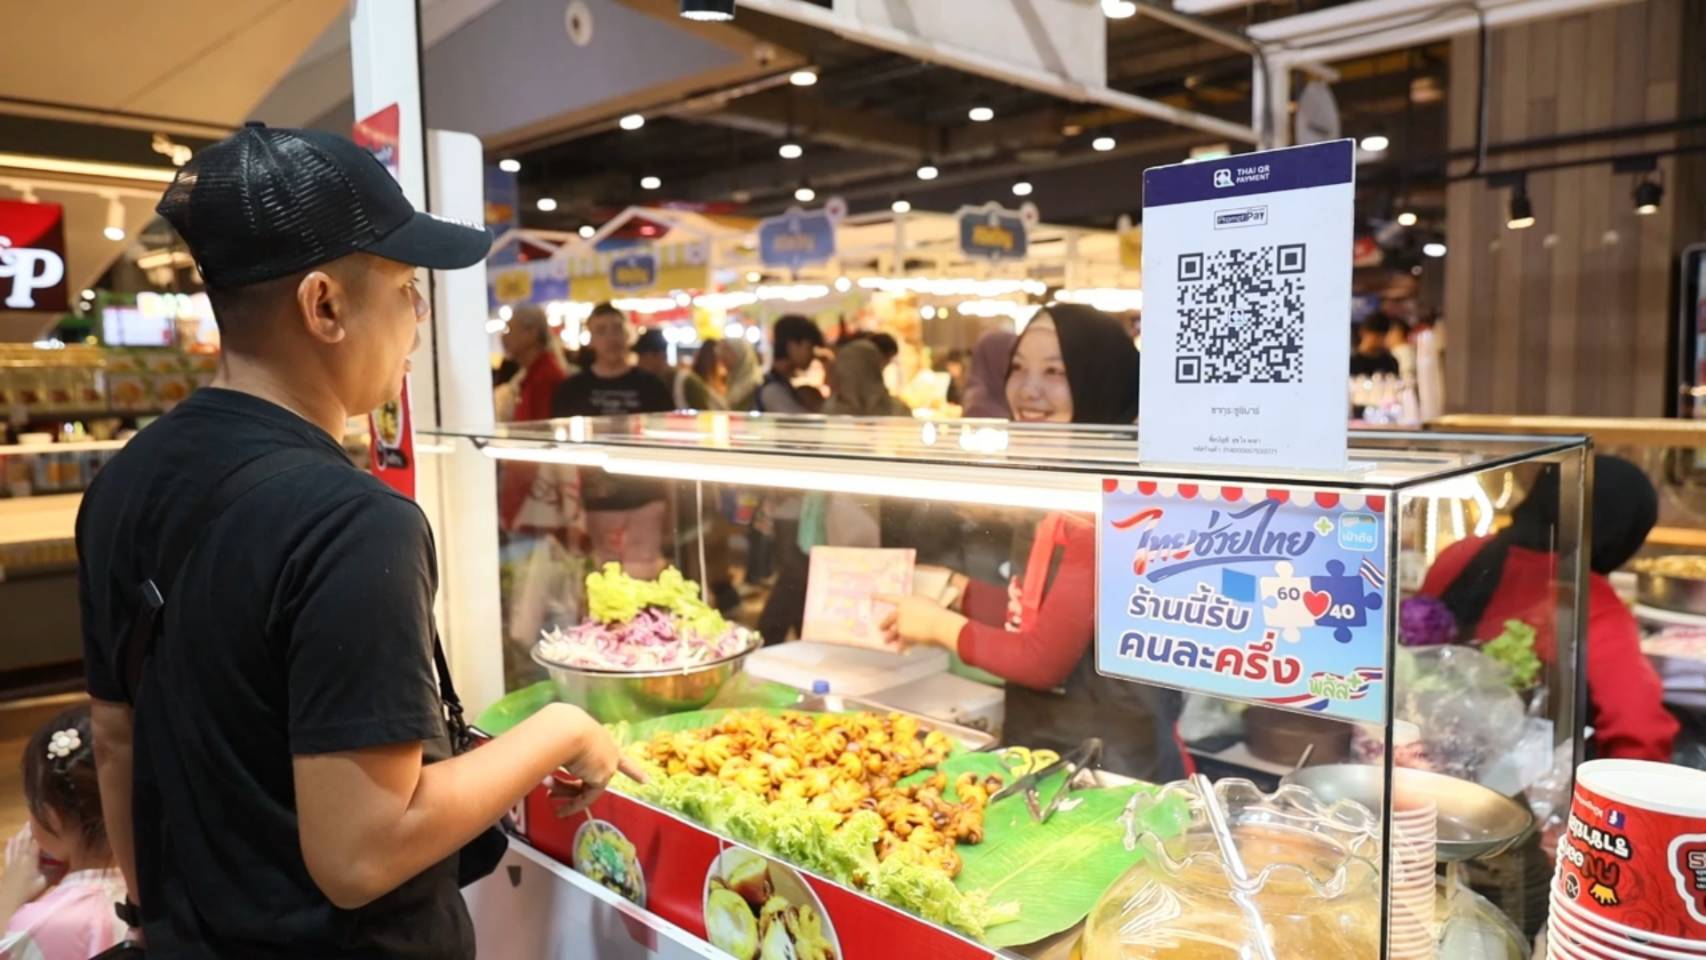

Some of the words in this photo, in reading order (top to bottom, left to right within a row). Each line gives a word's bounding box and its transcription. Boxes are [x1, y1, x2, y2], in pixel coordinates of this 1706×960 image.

[1237, 166, 1256, 176] THAI
[1258, 164, 1270, 174] QR
[1236, 173, 1270, 184] PAYMENT
[1277, 586, 1300, 601] 60
[1129, 585, 1249, 631] ร้านนี้รับ
[1329, 604, 1355, 619] 40
[1119, 631, 1301, 685] คนละครึ่ง
